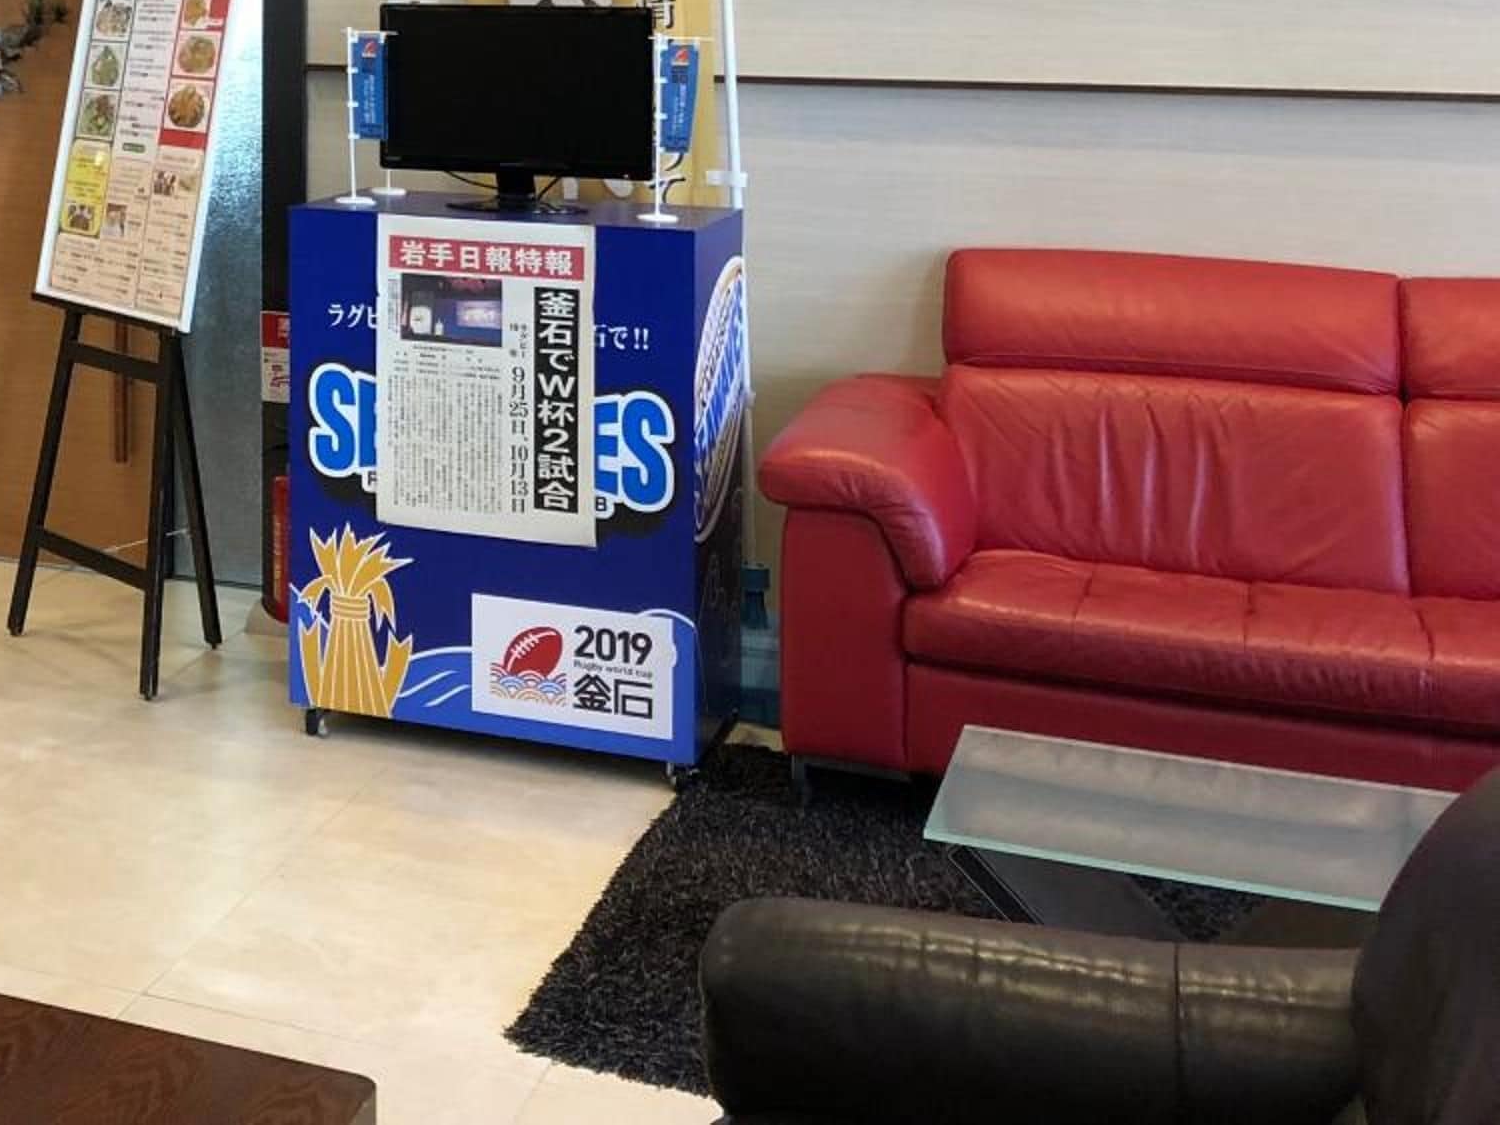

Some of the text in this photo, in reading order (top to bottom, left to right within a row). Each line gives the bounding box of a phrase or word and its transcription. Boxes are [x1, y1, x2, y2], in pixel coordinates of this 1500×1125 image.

[399, 239, 574, 276] 岩手日報特報
[536, 291, 576, 511] 釜石でW杯2試合
[573, 625, 653, 665] 2019
[573, 660, 604, 673] Rugby
[605, 665, 633, 676] world
